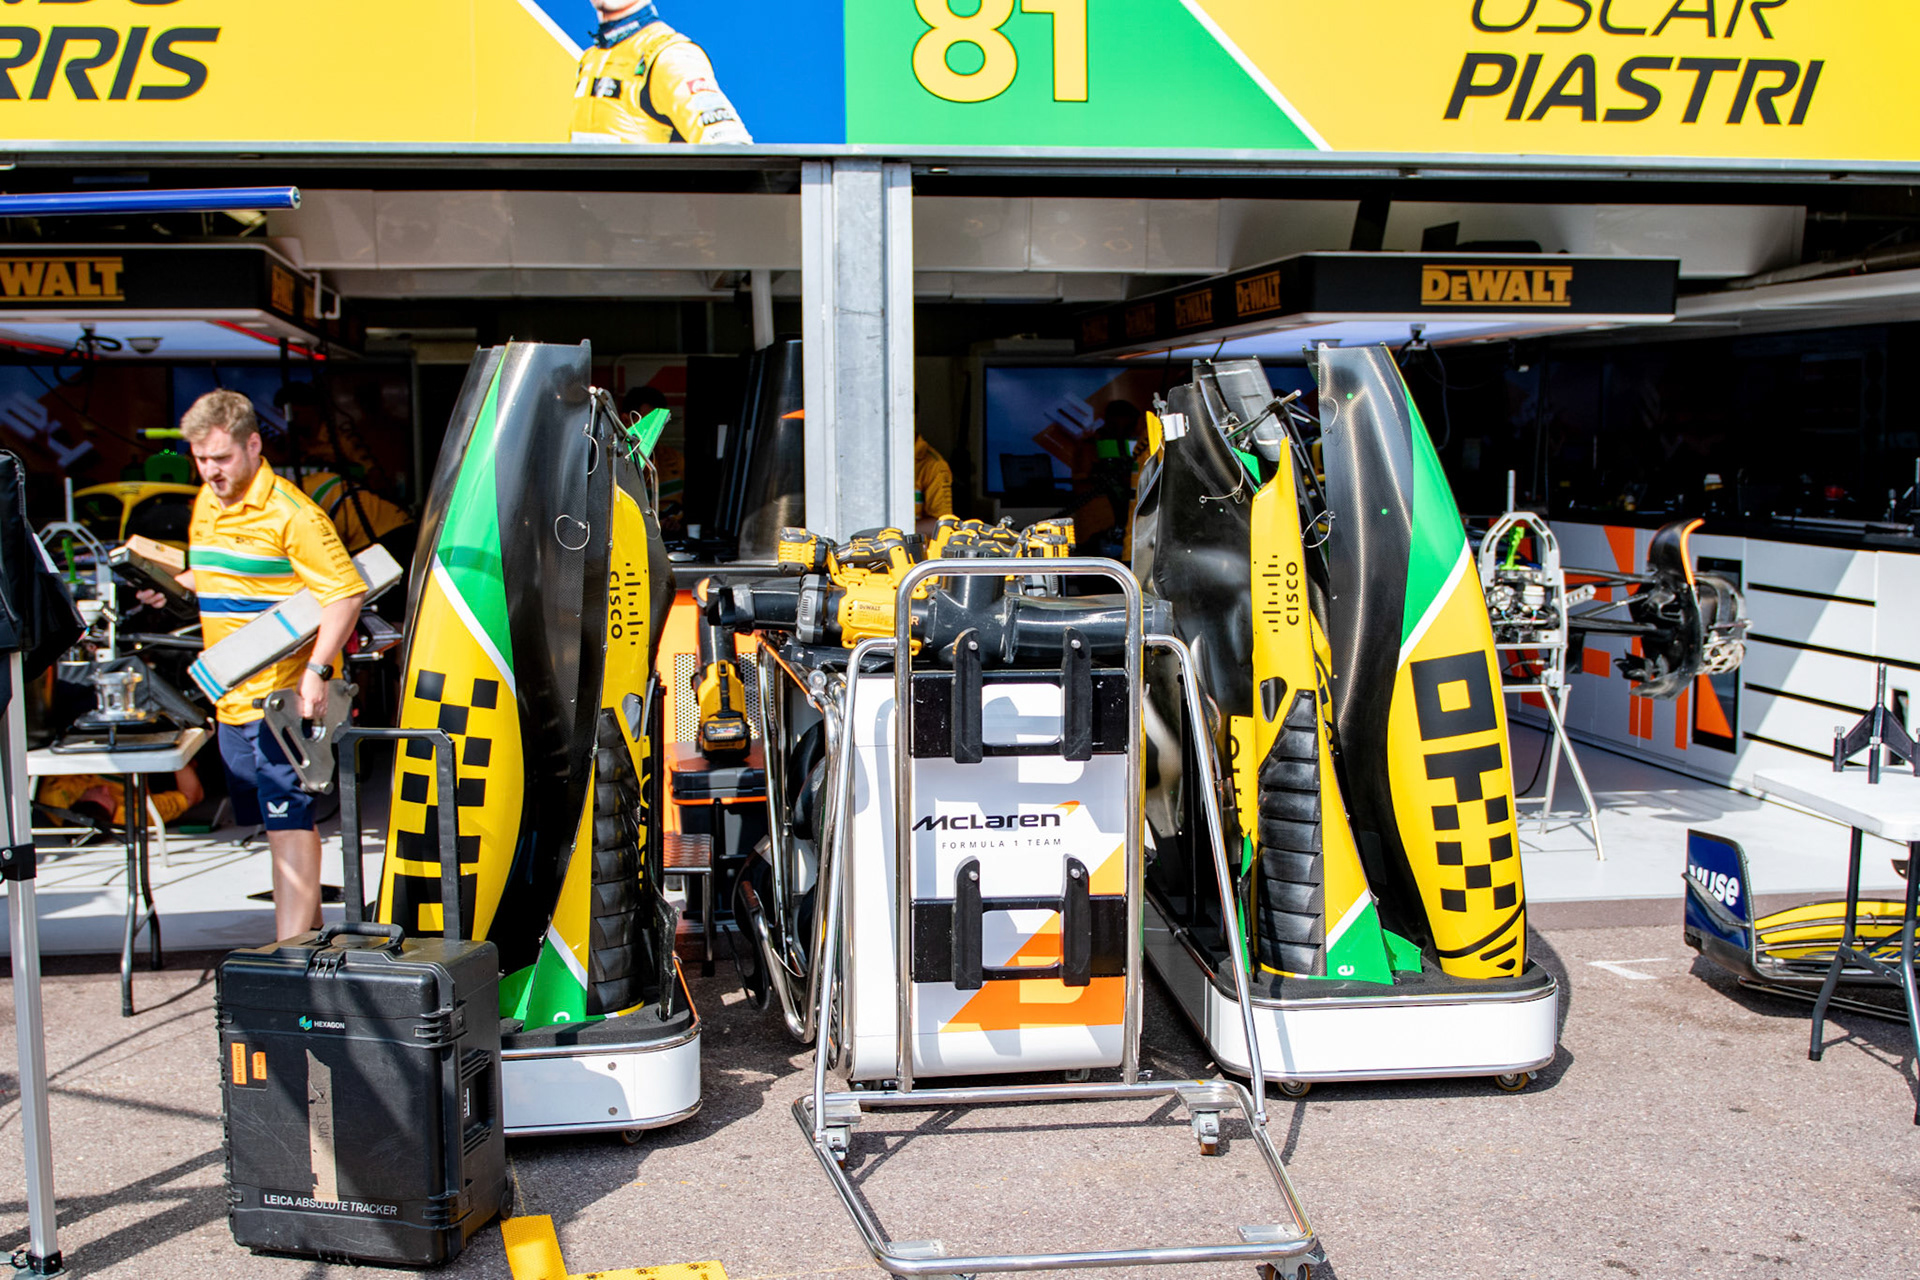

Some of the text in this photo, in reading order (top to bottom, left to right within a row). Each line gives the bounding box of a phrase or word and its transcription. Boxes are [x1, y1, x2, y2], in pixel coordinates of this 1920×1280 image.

[1471, 0, 1787, 39] OSCAR
[911, 0, 1089, 103] 81
[1442, 51, 1826, 126] PIASTRI
[609, 570, 623, 639] CISCO
[1285, 561, 1299, 626] CISCO
[912, 813, 1061, 831] McLaren
[942, 840, 1005, 850] FORMULA
[1028, 838, 1062, 846] TEAM
[314, 1020, 345, 1029] HEXAGON
[264, 1194, 398, 1215] LEICA ABSOLUTE TRACKER
